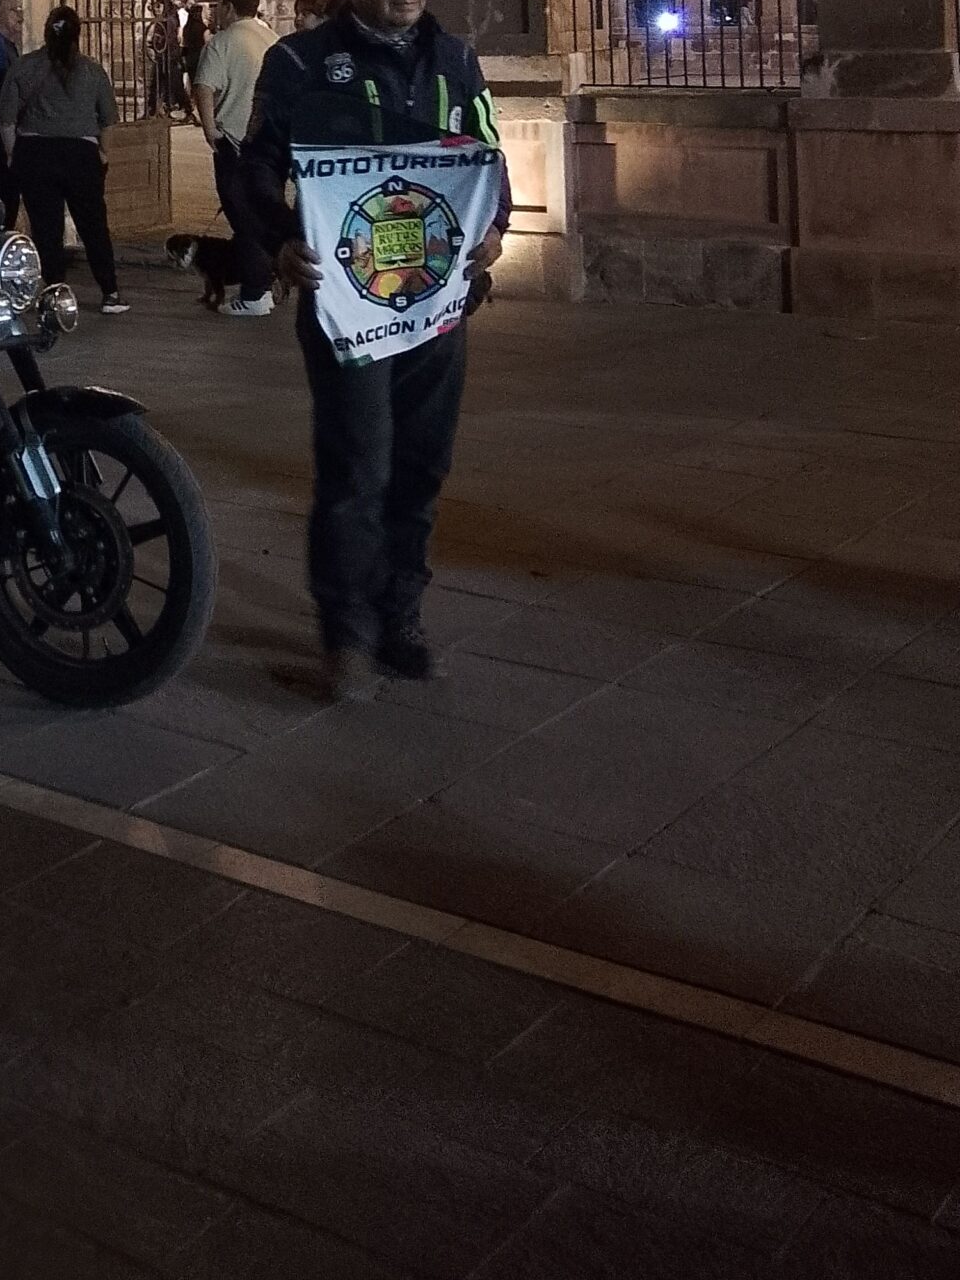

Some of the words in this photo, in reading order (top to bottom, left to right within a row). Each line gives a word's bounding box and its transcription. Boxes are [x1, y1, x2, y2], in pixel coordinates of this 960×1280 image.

[332, 64, 353, 80] 66
[292, 150, 498, 179] MOTOTURISMO
[388, 181, 402, 192] N
[451, 236, 464, 246] E
[395, 296, 407, 307] S
